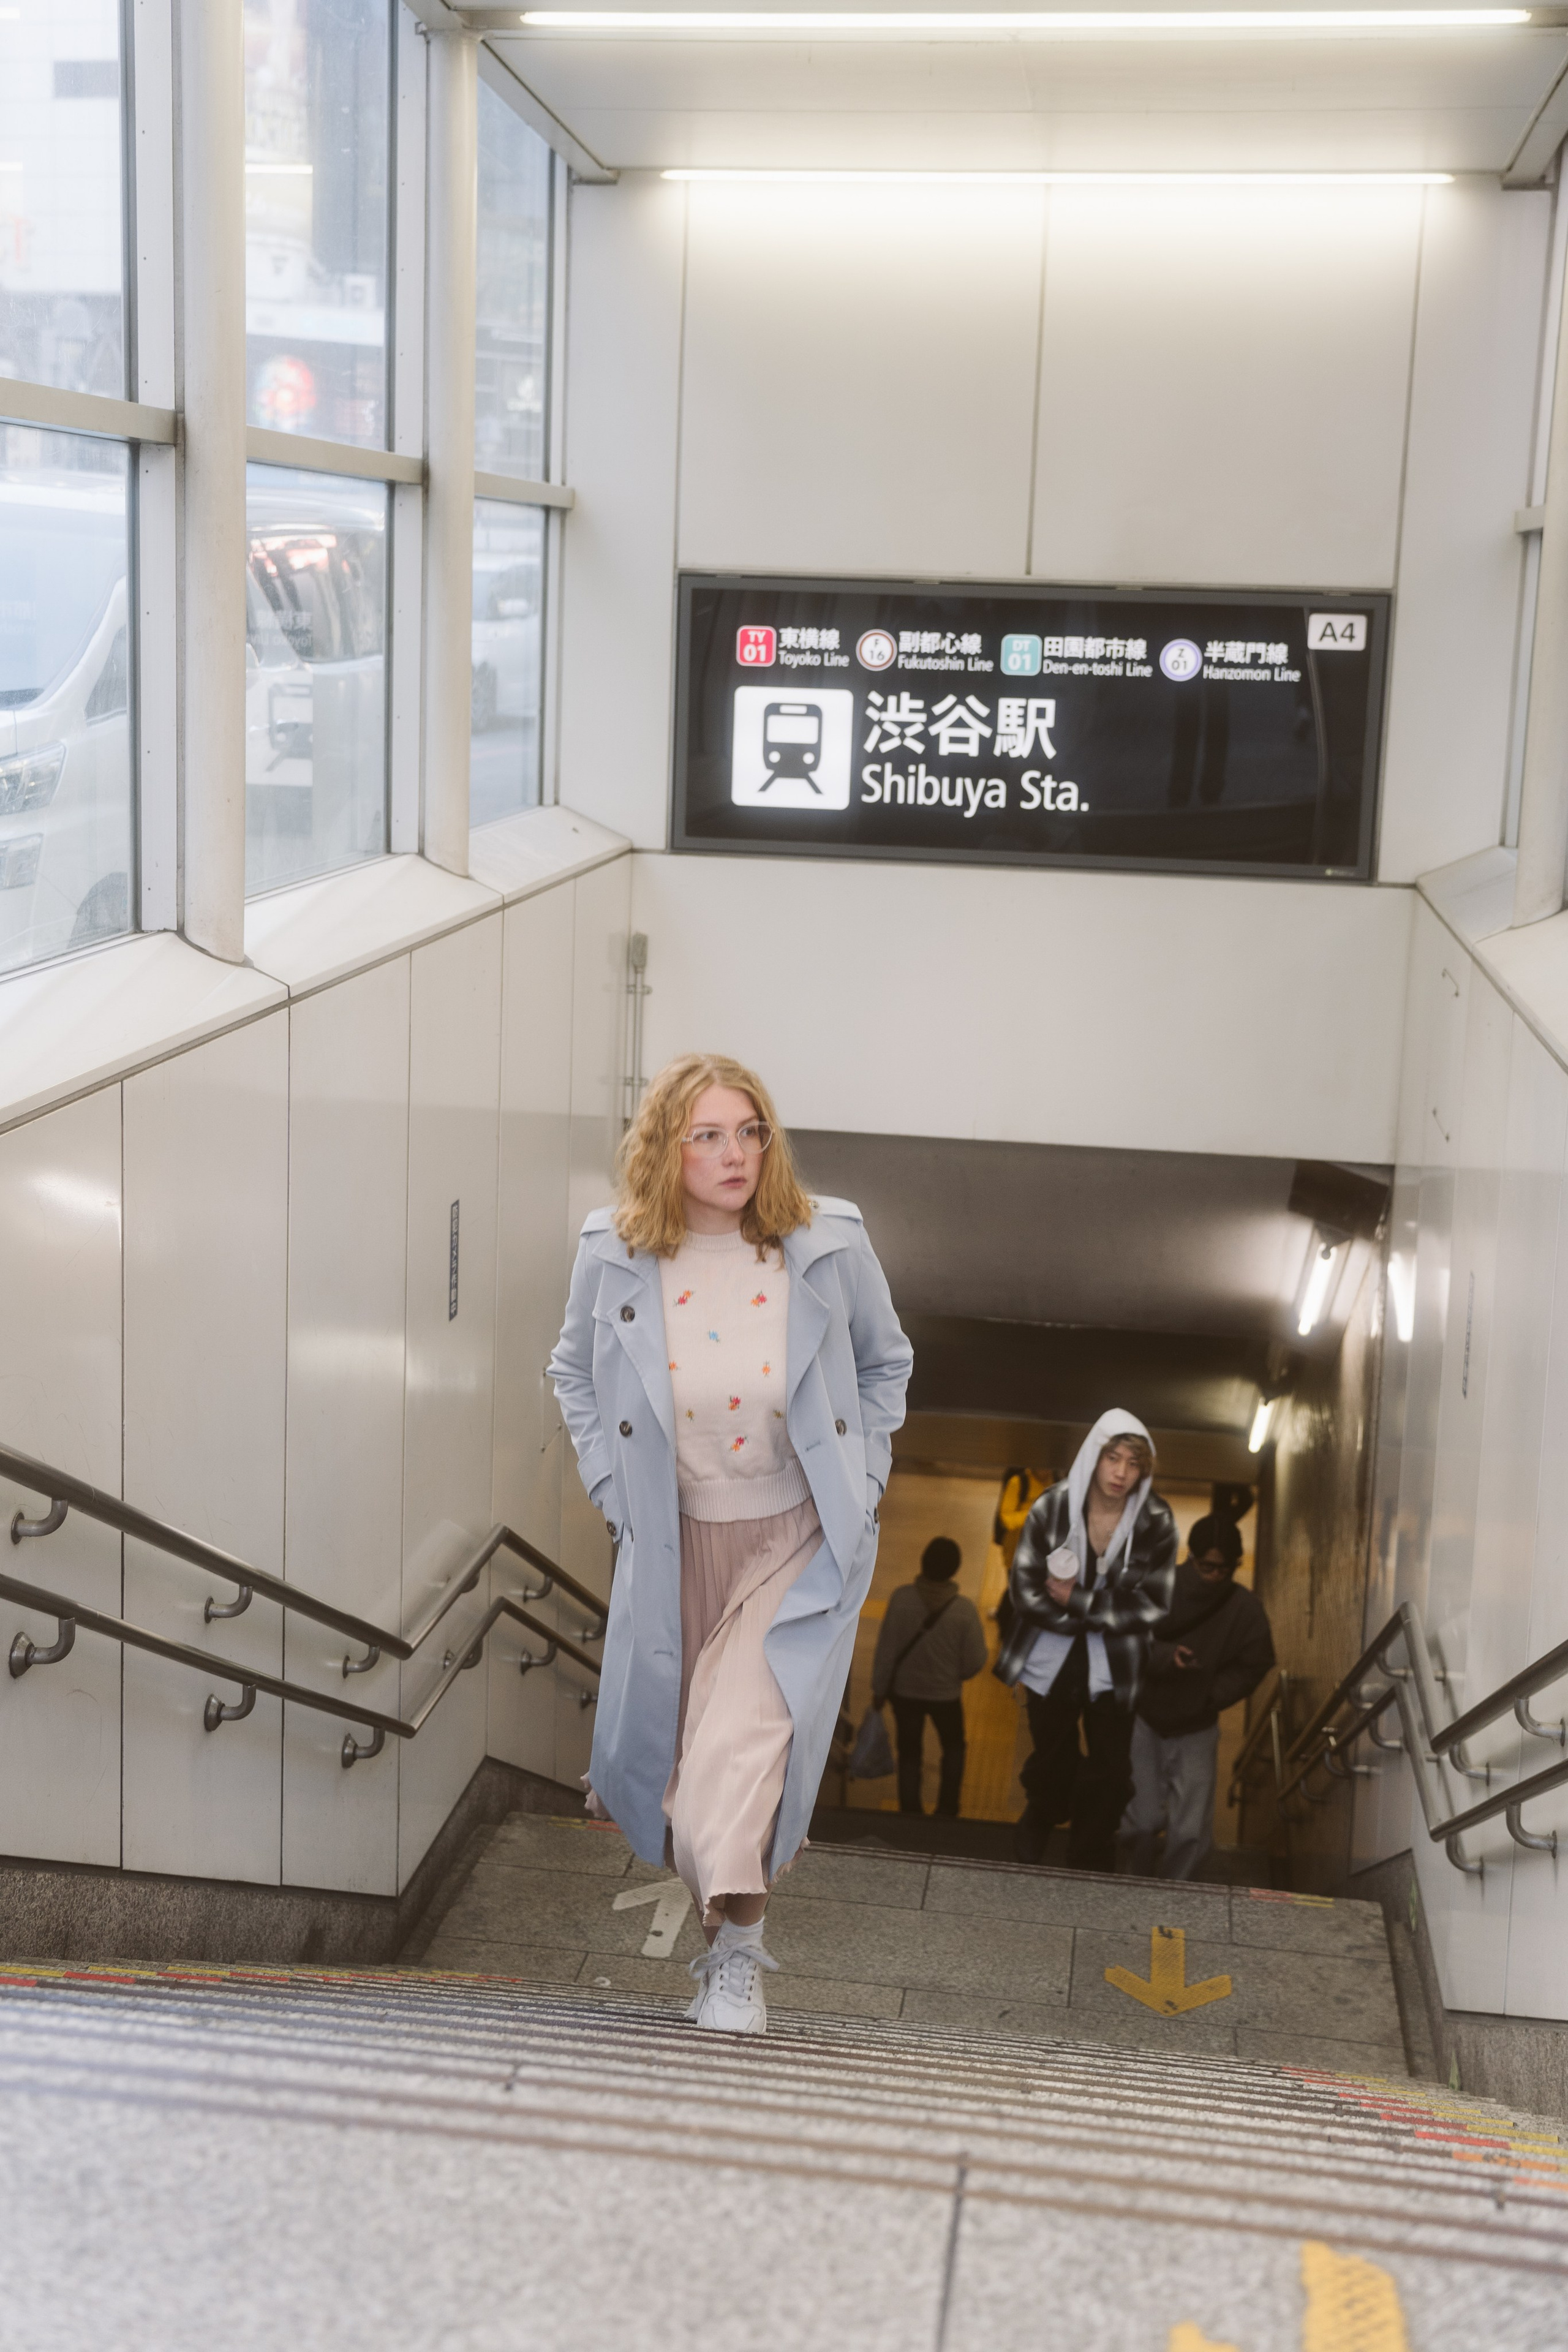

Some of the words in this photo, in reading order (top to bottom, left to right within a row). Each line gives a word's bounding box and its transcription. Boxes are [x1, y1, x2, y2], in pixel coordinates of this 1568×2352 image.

[748, 630, 766, 642] TY
[778, 627, 840, 650] 東横線
[1319, 622, 1355, 643] A4
[874, 638, 880, 647] F
[899, 631, 981, 655] 副都心線
[1012, 641, 1030, 652] DT
[1043, 636, 1147, 661] 田園都市線
[744, 644, 766, 662] 01
[778, 650, 821, 668] Toyoko
[824, 652, 850, 667] Line
[870, 650, 885, 661] 16
[1178, 648, 1185, 658] Z
[1204, 641, 1288, 665] 半蔵門線
[898, 655, 965, 671] Fukutoshin
[968, 657, 993, 672] Line
[1008, 654, 1031, 671] 01
[1042, 659, 1123, 676] Den-en-toshi
[1126, 662, 1153, 677] Line
[1170, 660, 1187, 671] 01
[1203, 666, 1271, 680] Hanzomon
[1274, 668, 1301, 682] Line
[864, 691, 1057, 760] 渋谷駅
[861, 762, 1006, 818] Shibuya
[1020, 771, 1089, 812] Sta.
